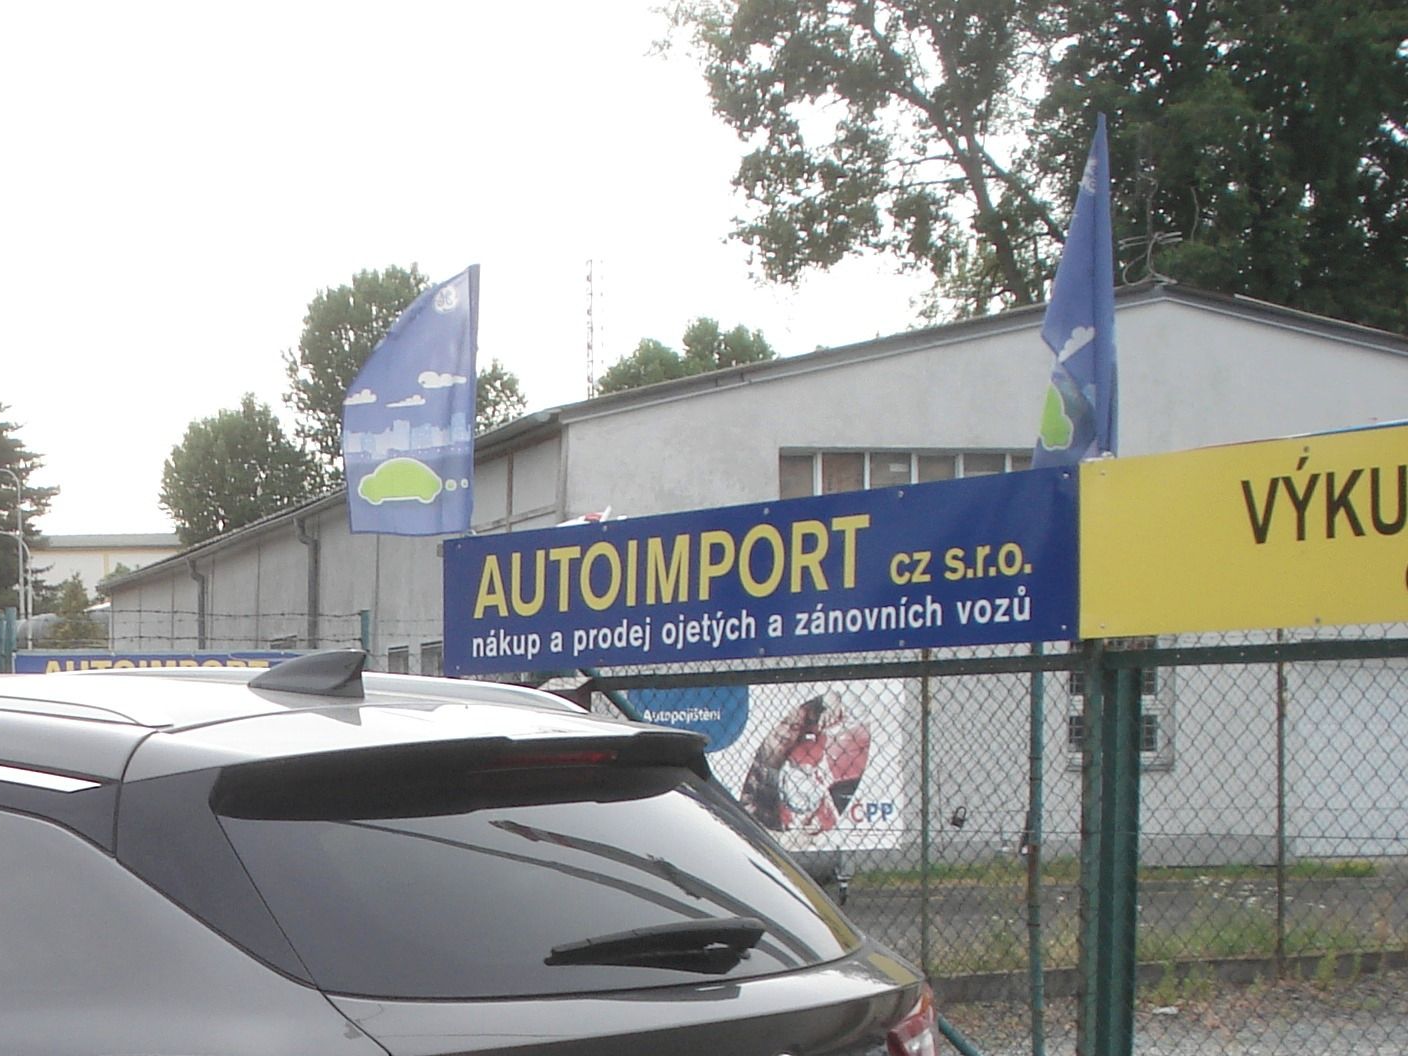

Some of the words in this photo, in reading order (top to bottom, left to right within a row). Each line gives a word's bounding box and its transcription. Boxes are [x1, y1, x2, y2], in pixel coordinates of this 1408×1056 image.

[1241, 456, 1408, 545] VÝKU
[473, 514, 870, 619] AUTOIMPORT
[890, 551, 932, 585] cz
[944, 542, 1032, 580] s.r.o.
[472, 629, 541, 660] nákup
[550, 631, 563, 652] a
[573, 618, 651, 656] prodej
[662, 609, 756, 650] ojetých
[768, 613, 783, 637] a
[795, 595, 943, 636] zánovních
[956, 585, 1031, 625] vozů
[850, 799, 893, 823] ČPP
